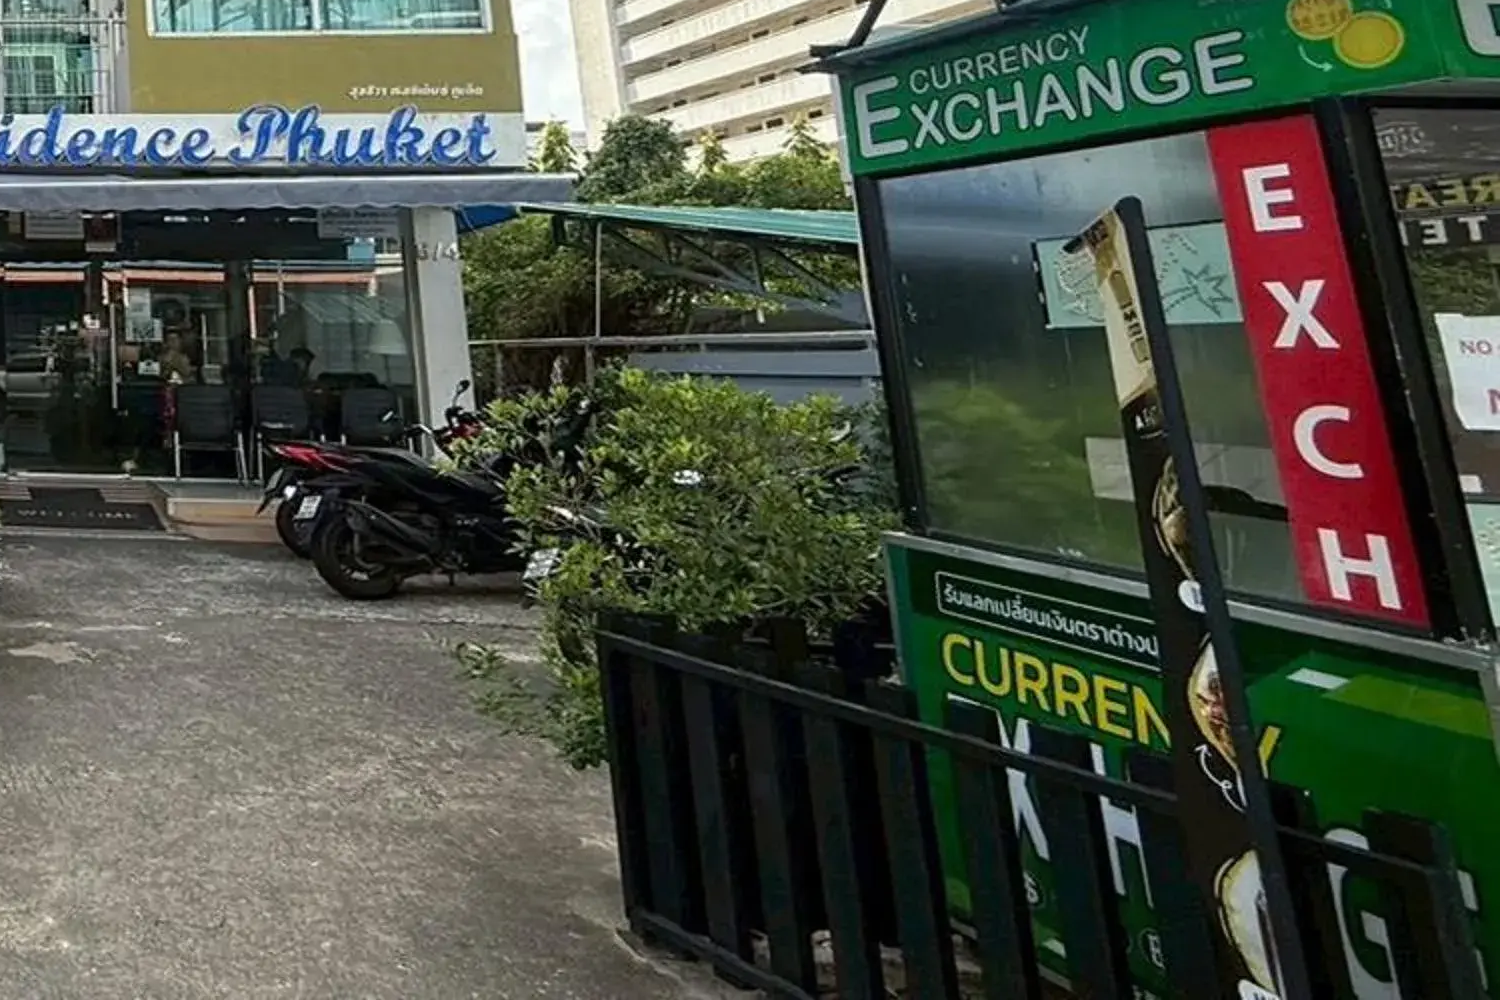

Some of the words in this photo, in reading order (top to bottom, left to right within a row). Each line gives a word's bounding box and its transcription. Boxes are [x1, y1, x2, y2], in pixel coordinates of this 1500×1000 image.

[853, 30, 1255, 159] EXCHANGE
[909, 25, 1090, 94] CURRENCY
[229, 104, 498, 166] Phuket
[941, 632, 1282, 780] CURREN
